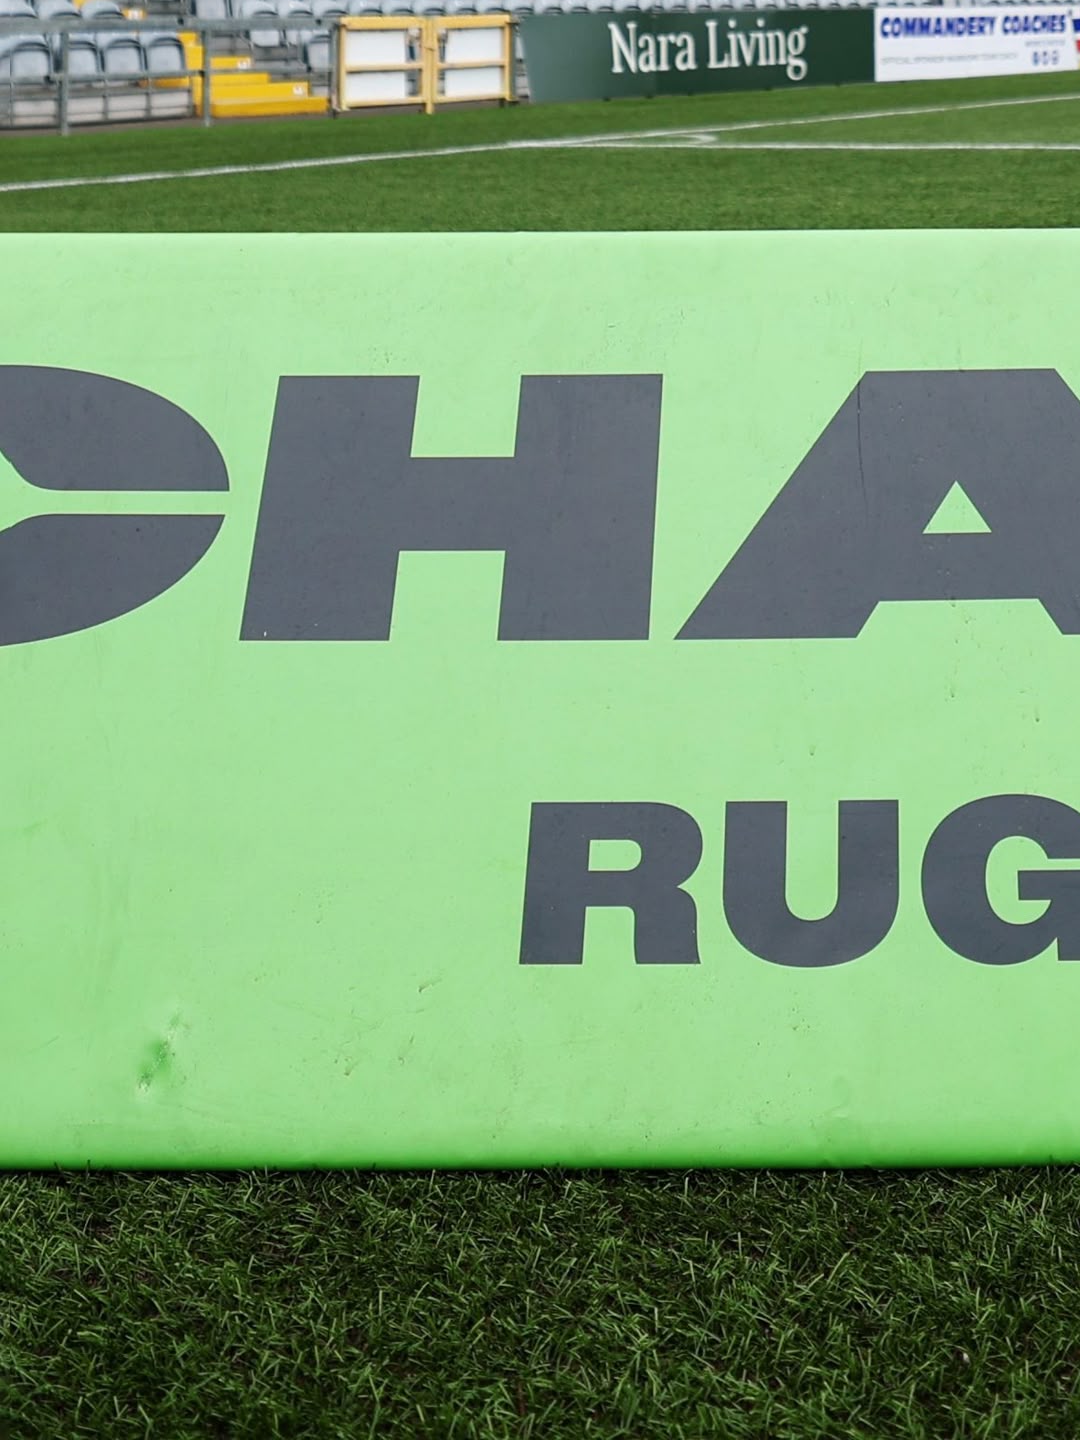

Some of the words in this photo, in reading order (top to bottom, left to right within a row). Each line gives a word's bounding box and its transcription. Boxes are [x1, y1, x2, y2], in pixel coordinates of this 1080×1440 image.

[880, 16, 996, 39] COMMANDERY
[1002, 14, 1067, 34] COACHES
[607, 21, 698, 74] Nara
[705, 18, 808, 81] Living
